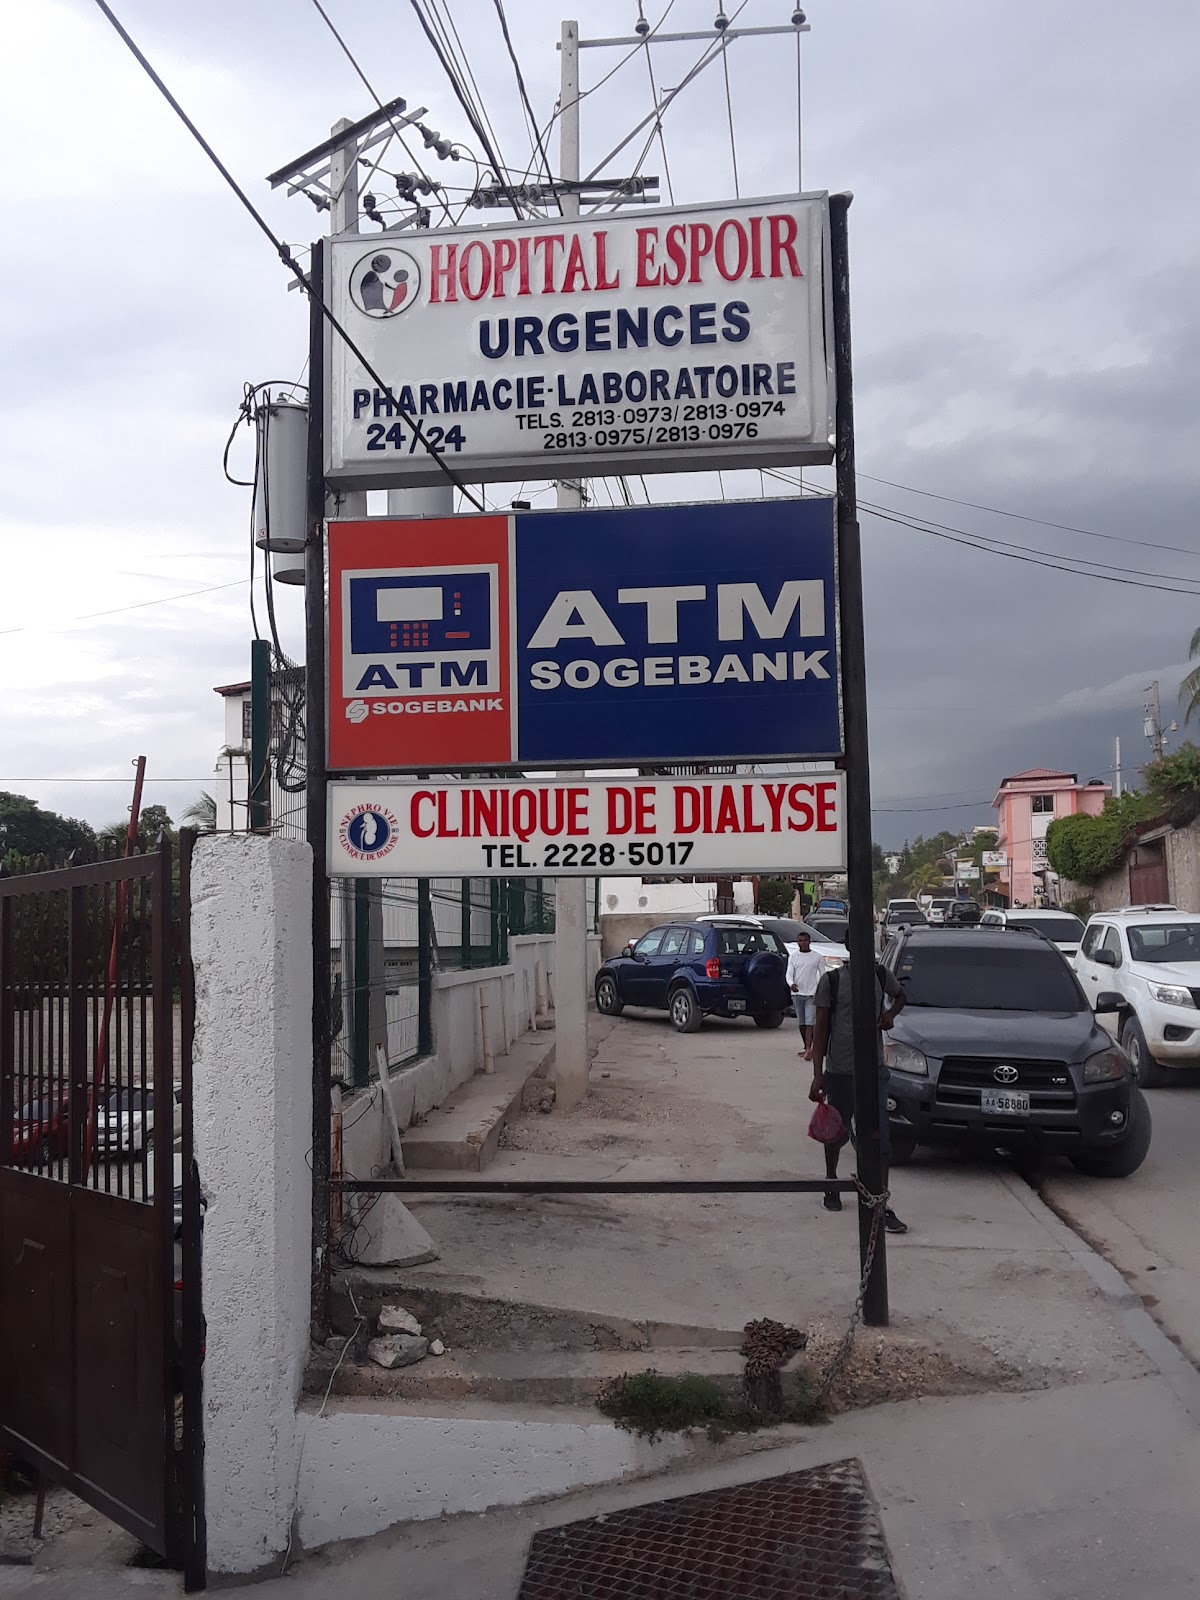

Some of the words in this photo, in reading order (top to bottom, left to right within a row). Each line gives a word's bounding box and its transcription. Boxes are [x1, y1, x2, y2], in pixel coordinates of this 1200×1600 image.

[428, 230, 620, 303] HOPITAL
[635, 213, 803, 288] ESPOIR
[478, 300, 751, 359] URGENCES
[515, 412, 565, 430] TELS.
[526, 578, 826, 649] ATM
[355, 659, 488, 691] ATM
[529, 649, 832, 690] SOGEBANK
[371, 698, 504, 715] SOGEBANK
[340, 803, 382, 828] NEPHRO
[383, 808, 399, 827] VIE
[410, 788, 590, 843] CLINIQUE
[606, 786, 657, 835] DE
[673, 782, 838, 834] DIALYSE
[366, 853, 377, 861] DE
[482, 844, 537, 868] TEL.
[543, 841, 694, 867] 2228-5017
